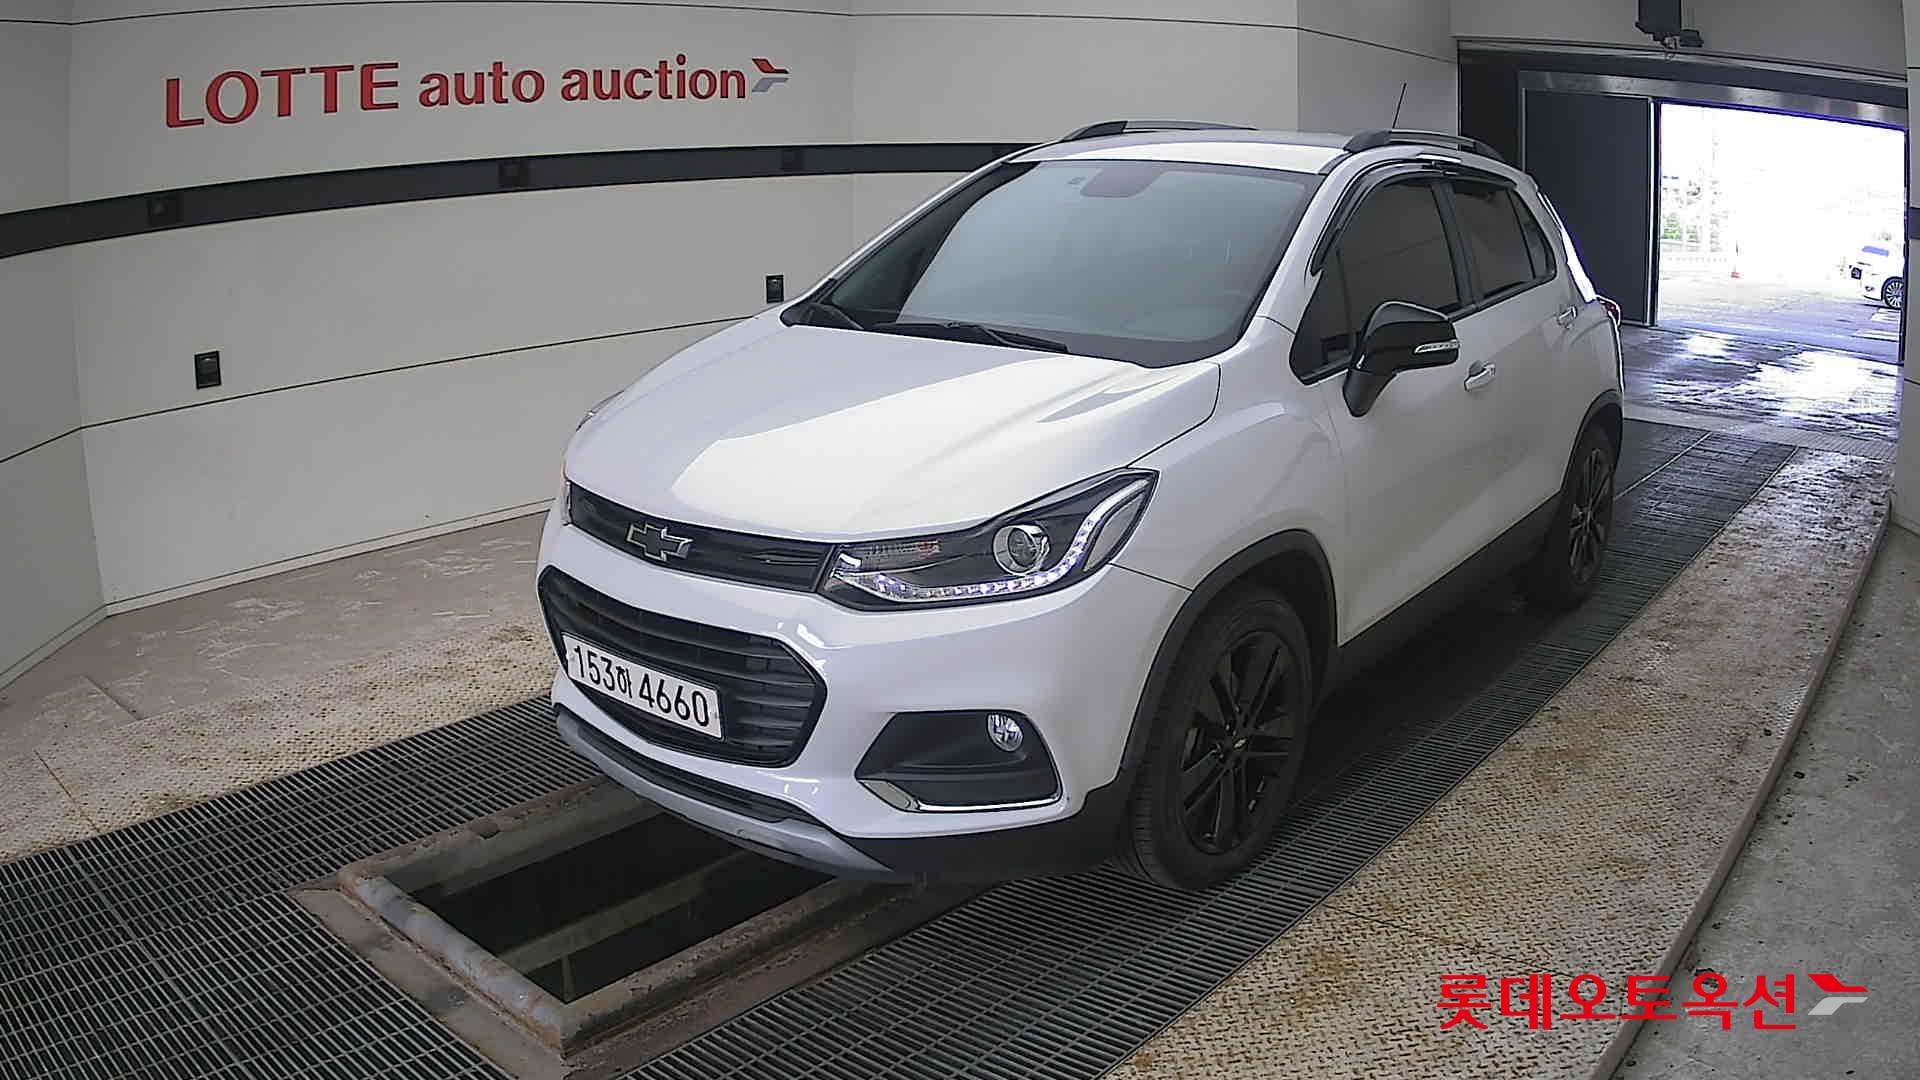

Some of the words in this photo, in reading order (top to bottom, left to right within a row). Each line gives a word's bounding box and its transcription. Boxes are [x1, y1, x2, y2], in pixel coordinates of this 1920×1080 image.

[165, 63, 399, 128] LOTTE
[418, 61, 545, 107] auto
[561, 53, 747, 101] auction
[639, 673, 710, 727] 4660
